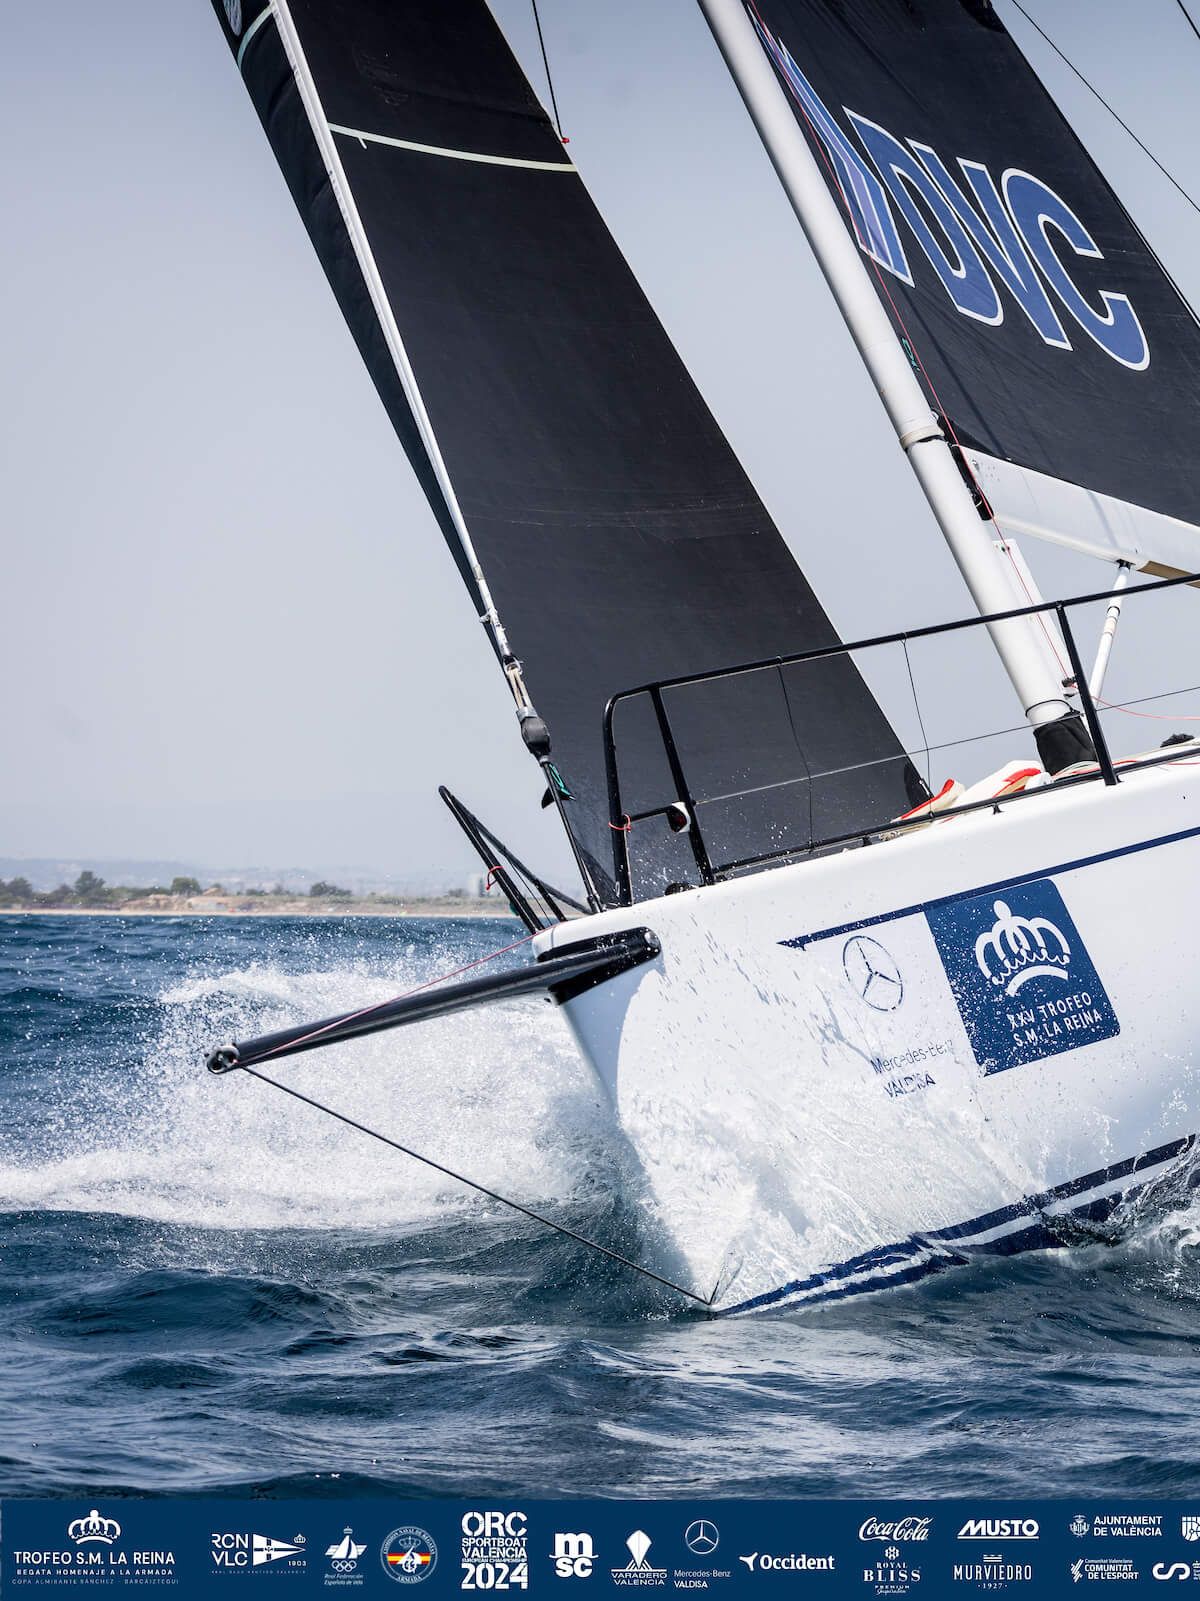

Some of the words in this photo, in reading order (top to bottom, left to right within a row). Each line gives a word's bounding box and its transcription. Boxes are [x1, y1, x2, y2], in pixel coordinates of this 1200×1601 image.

[842, 105, 1151, 371] DVC
[1006, 1009, 1035, 1028] XXV
[1037, 992, 1092, 1018] TROFEO
[1043, 1021, 1062, 1037] LA
[1064, 1009, 1102, 1031] REINA
